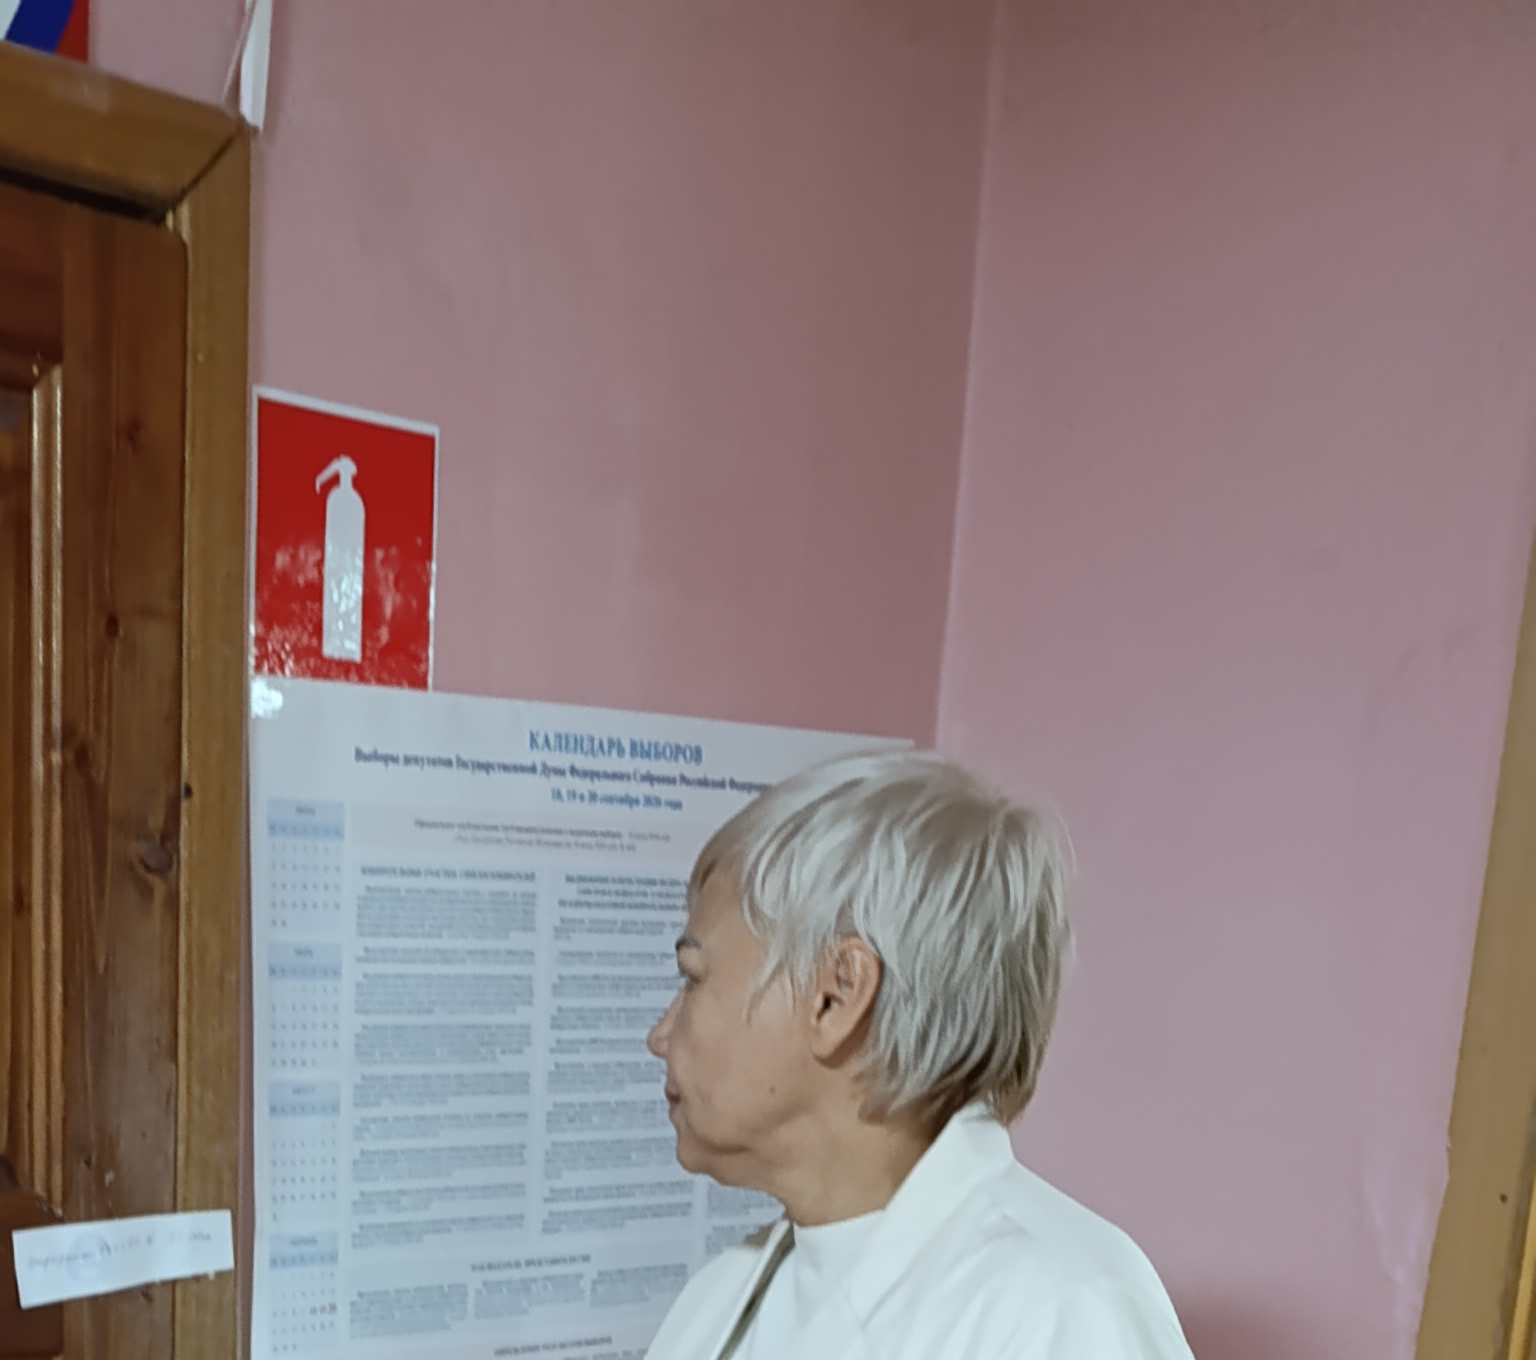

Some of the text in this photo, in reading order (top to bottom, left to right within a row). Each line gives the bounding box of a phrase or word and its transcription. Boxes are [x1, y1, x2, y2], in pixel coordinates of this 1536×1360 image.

[354, 747, 400, 769] Выборы
[528, 730, 703, 765] КАЛЕНДАРЬ ВЫБОРОВ
